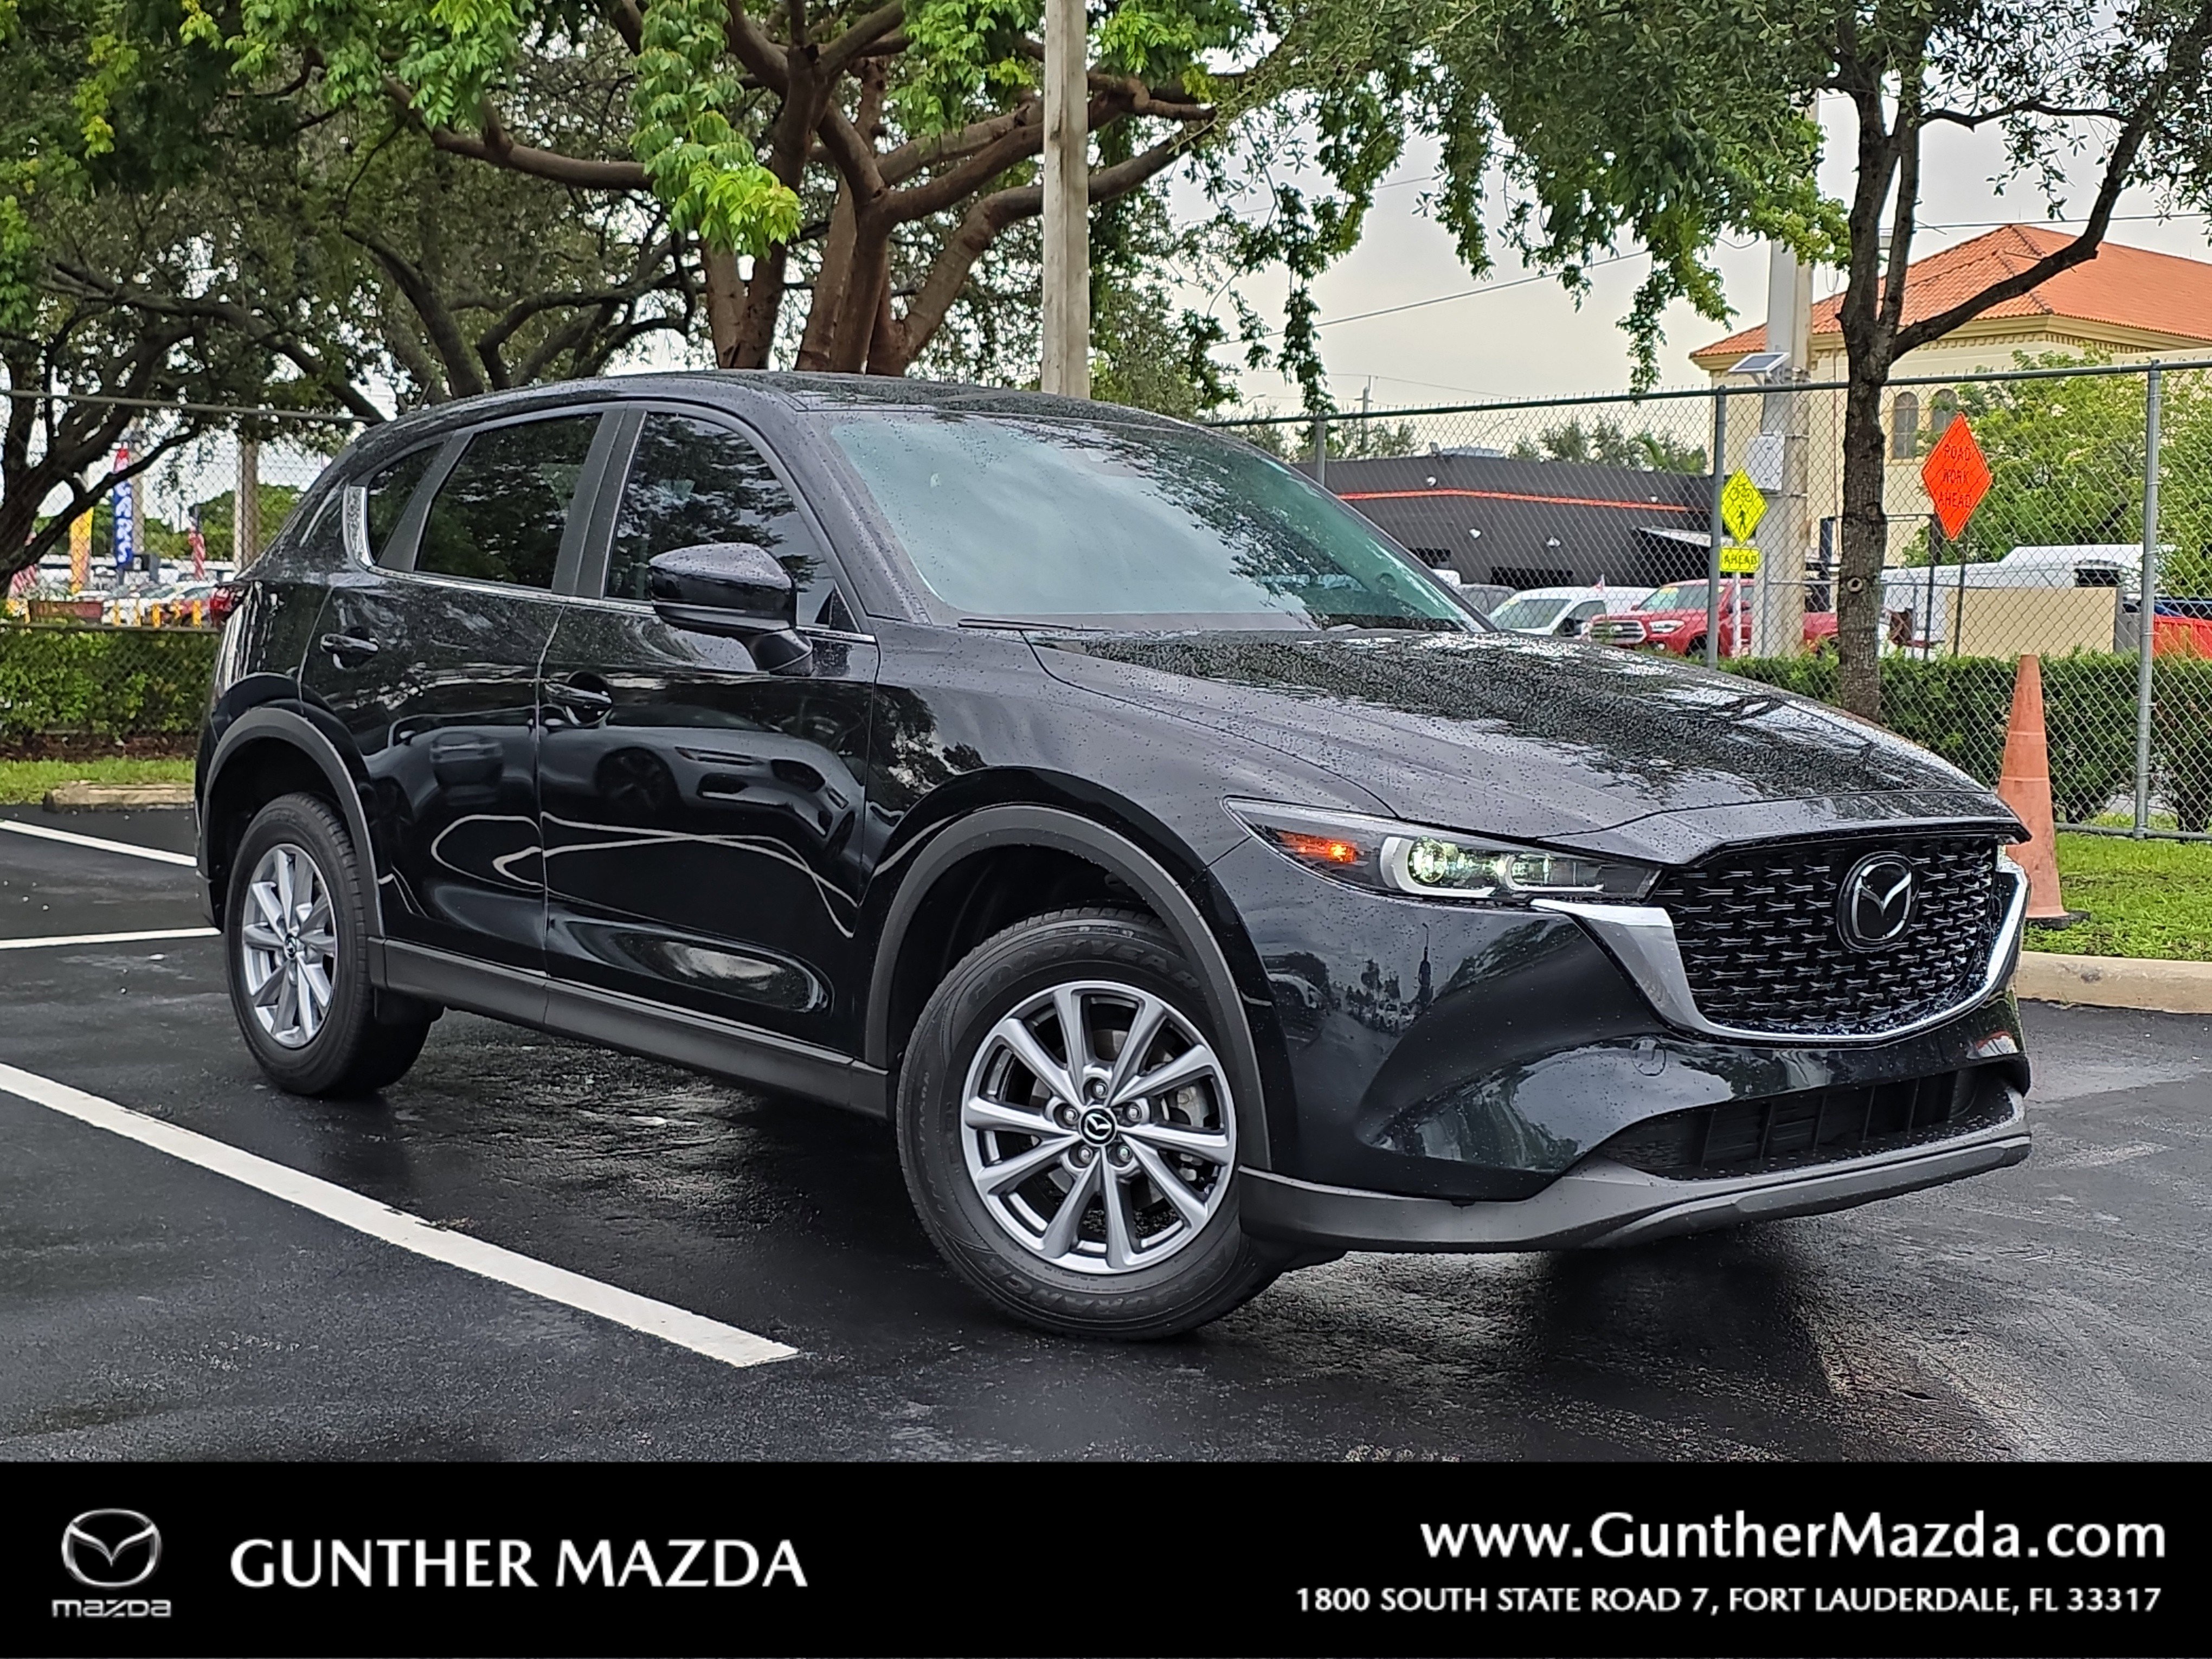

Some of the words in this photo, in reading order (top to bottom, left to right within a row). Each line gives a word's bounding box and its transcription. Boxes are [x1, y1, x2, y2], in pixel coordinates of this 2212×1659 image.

[1943, 444, 1972, 461] ROAD
[1943, 469, 1970, 484] WORK
[1938, 491, 1972, 508] AHEAD
[1724, 554, 1758, 565] AHEAD
